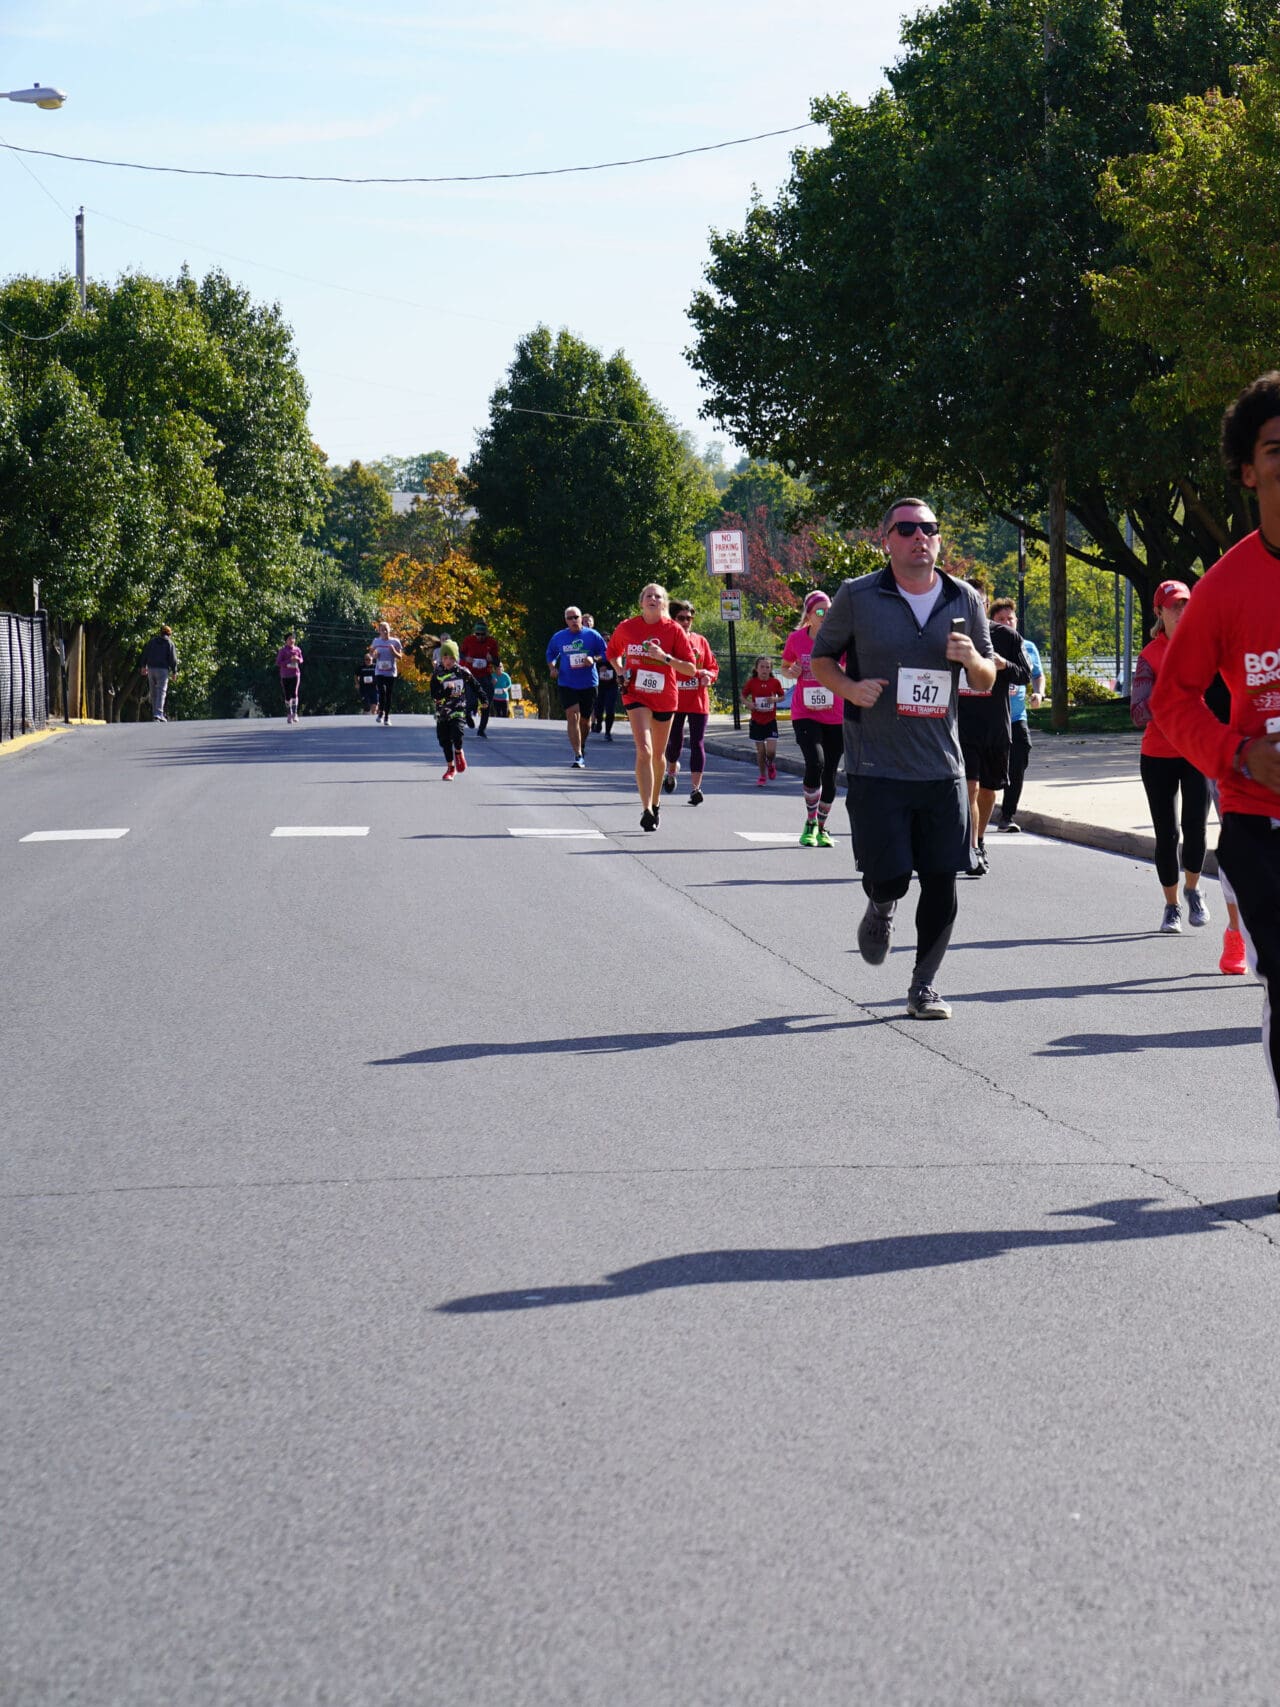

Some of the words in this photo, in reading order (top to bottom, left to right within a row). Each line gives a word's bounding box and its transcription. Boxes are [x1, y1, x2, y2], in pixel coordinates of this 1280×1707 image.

[721, 534, 731, 542] NO
[715, 543, 739, 551] PARKING
[642, 678, 658, 689] 498
[811, 694, 826, 705] 559
[912, 684, 939, 704] 547
[898, 704, 917, 713] APPLE
[917, 705, 939, 715] TRAMPLE
